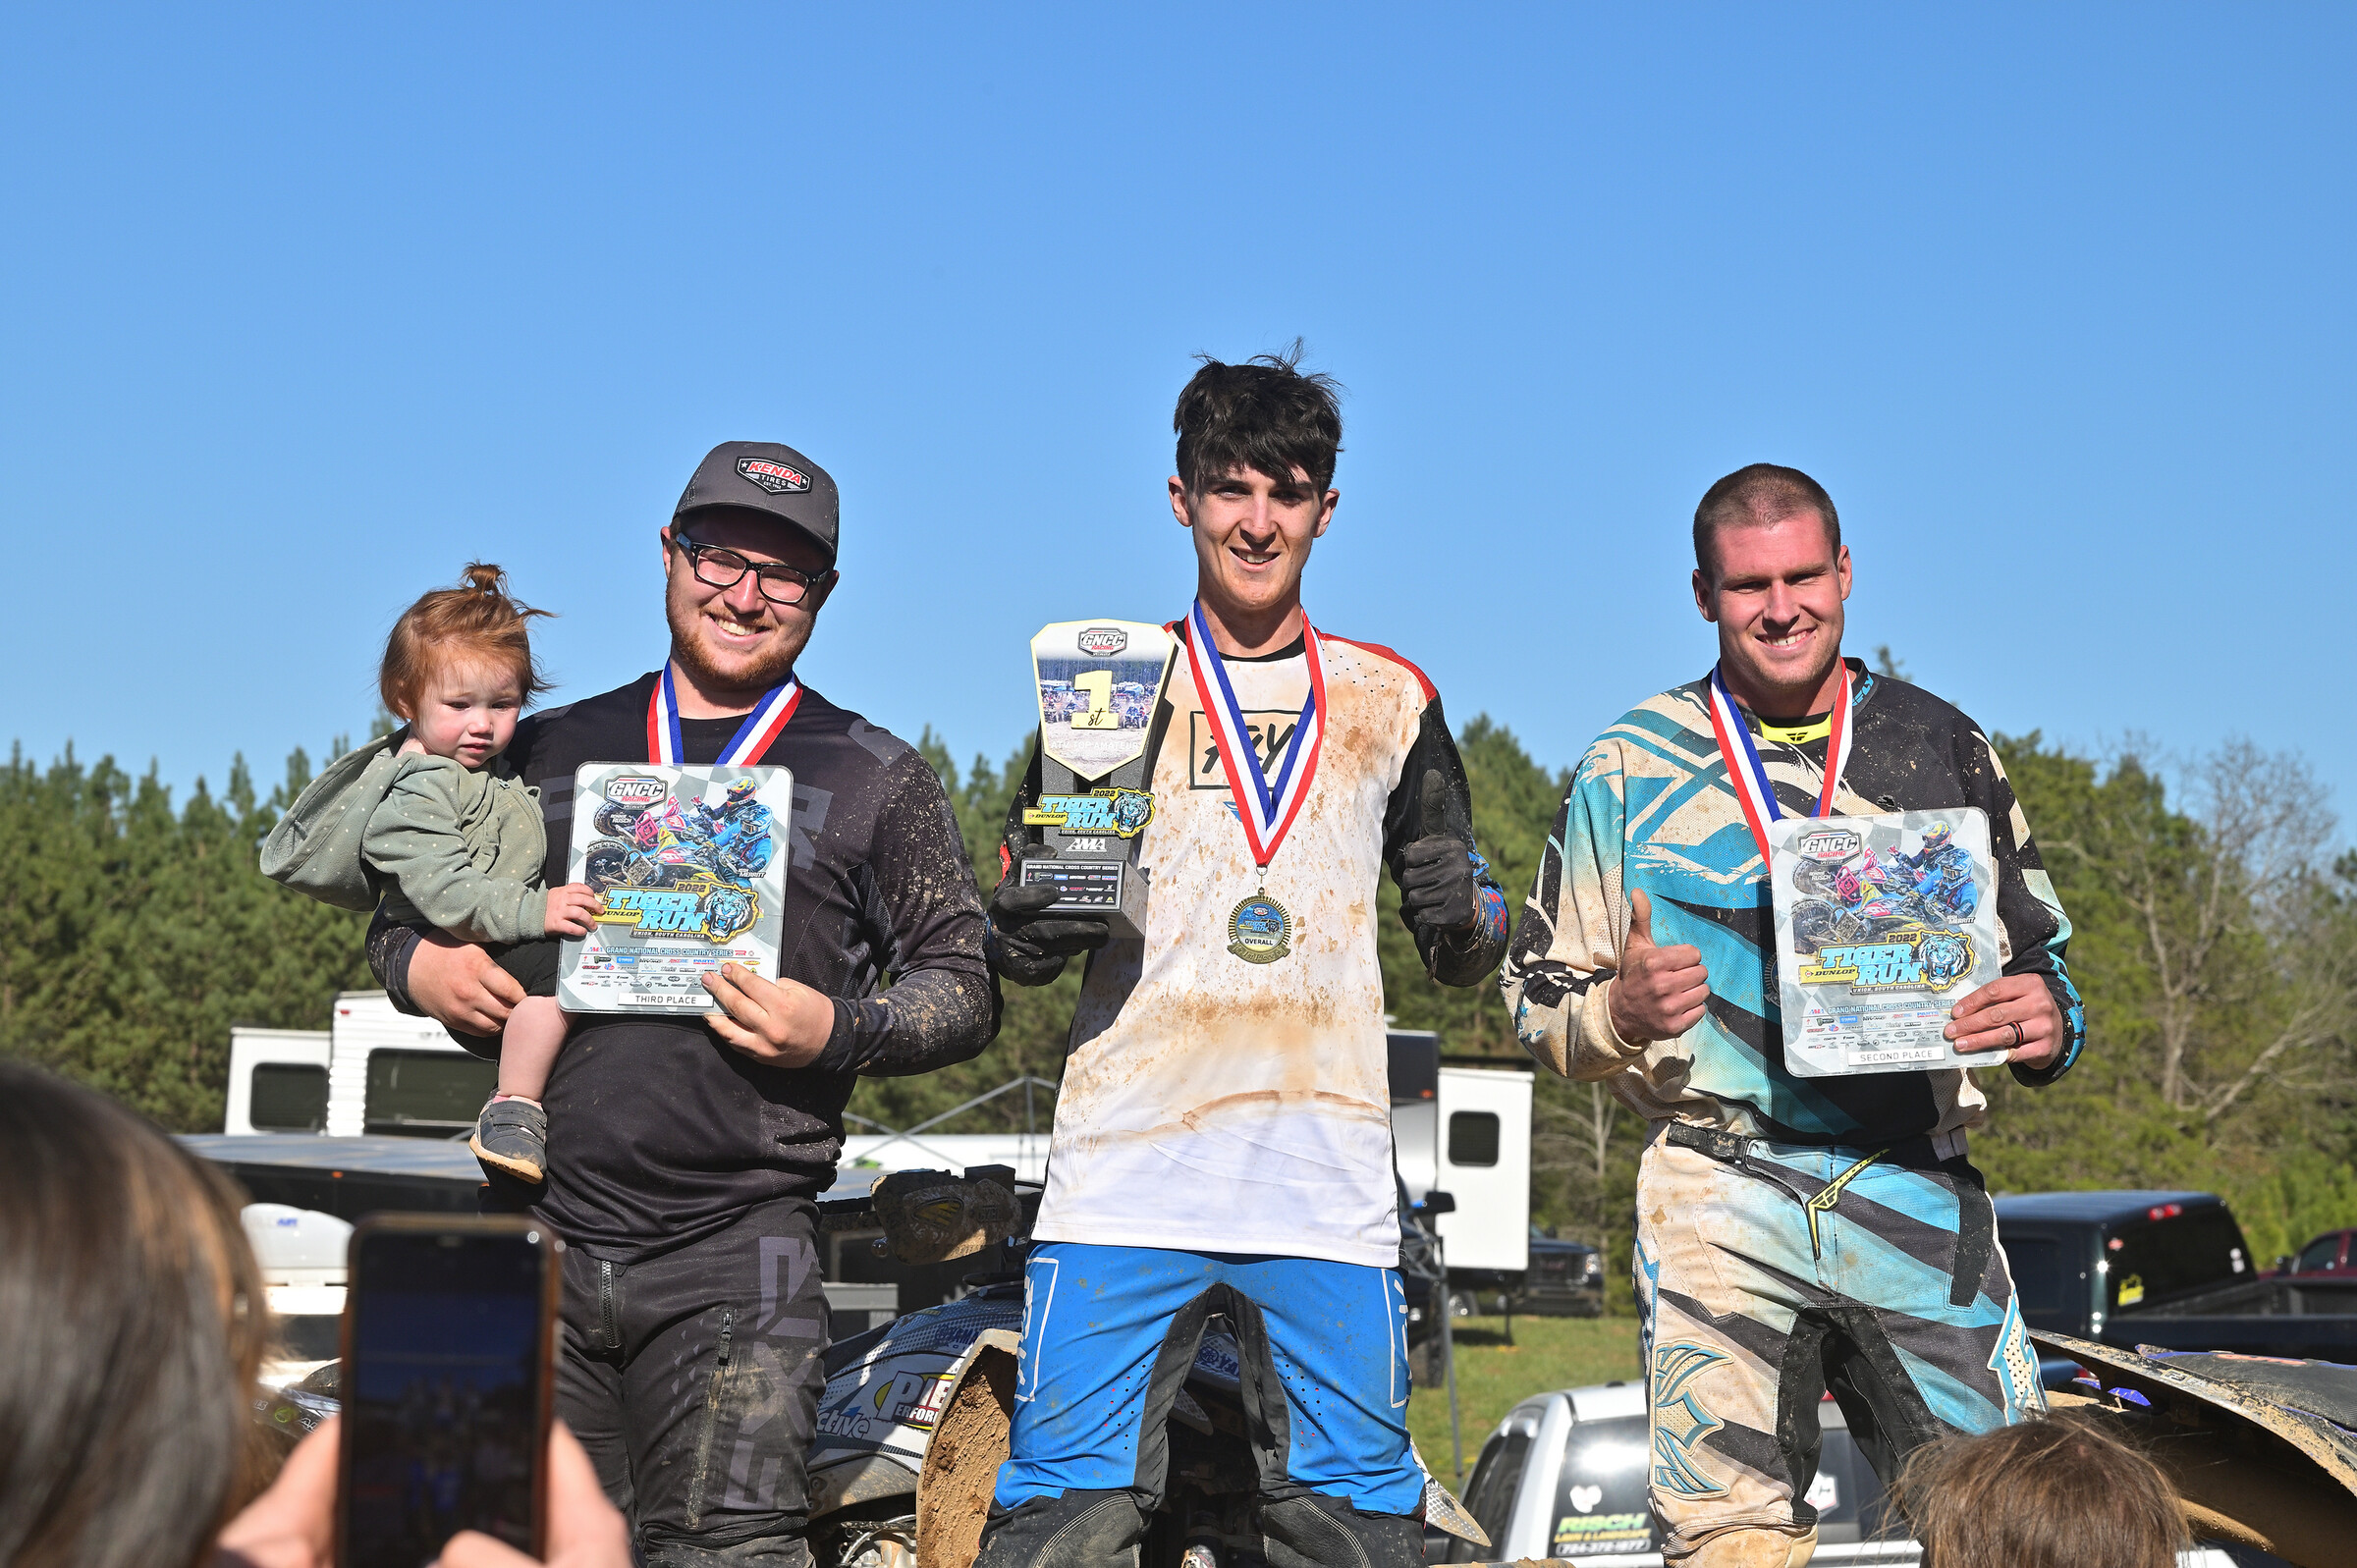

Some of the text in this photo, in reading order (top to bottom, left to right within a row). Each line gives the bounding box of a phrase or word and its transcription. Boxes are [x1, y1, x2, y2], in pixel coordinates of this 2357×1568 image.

[747, 461, 802, 485] KENDA
[761, 474, 787, 486] TIRES
[1081, 634, 1125, 646] GNCC
[1073, 740, 1092, 749] TOP
[1094, 740, 1139, 749] AMATEUR
[609, 783, 664, 796] GNCC
[1041, 796, 1112, 813] TIGER
[1064, 812, 1117, 829] RUN
[1066, 838, 1108, 852] AMA
[1803, 836, 1858, 853] GNCC
[678, 883, 706, 892] 2022
[607, 890, 700, 912] TIGER
[636, 909, 707, 932] RUN
[1889, 933, 1918, 943] 2022
[629, 946, 659, 955] NATIONAL
[682, 947, 710, 956] COUNTRY
[1820, 944, 1913, 968] TIGER
[1854, 962, 1923, 986] RUN
[635, 995, 697, 1004] THIRD PLACE
[1850, 1003, 1881, 1013] NATIONAL
[1903, 1000, 1933, 1009] COUNTRY
[1860, 1050, 1933, 1062] SECOND PLACE
[1557, 1513, 1648, 1533] RISCH
